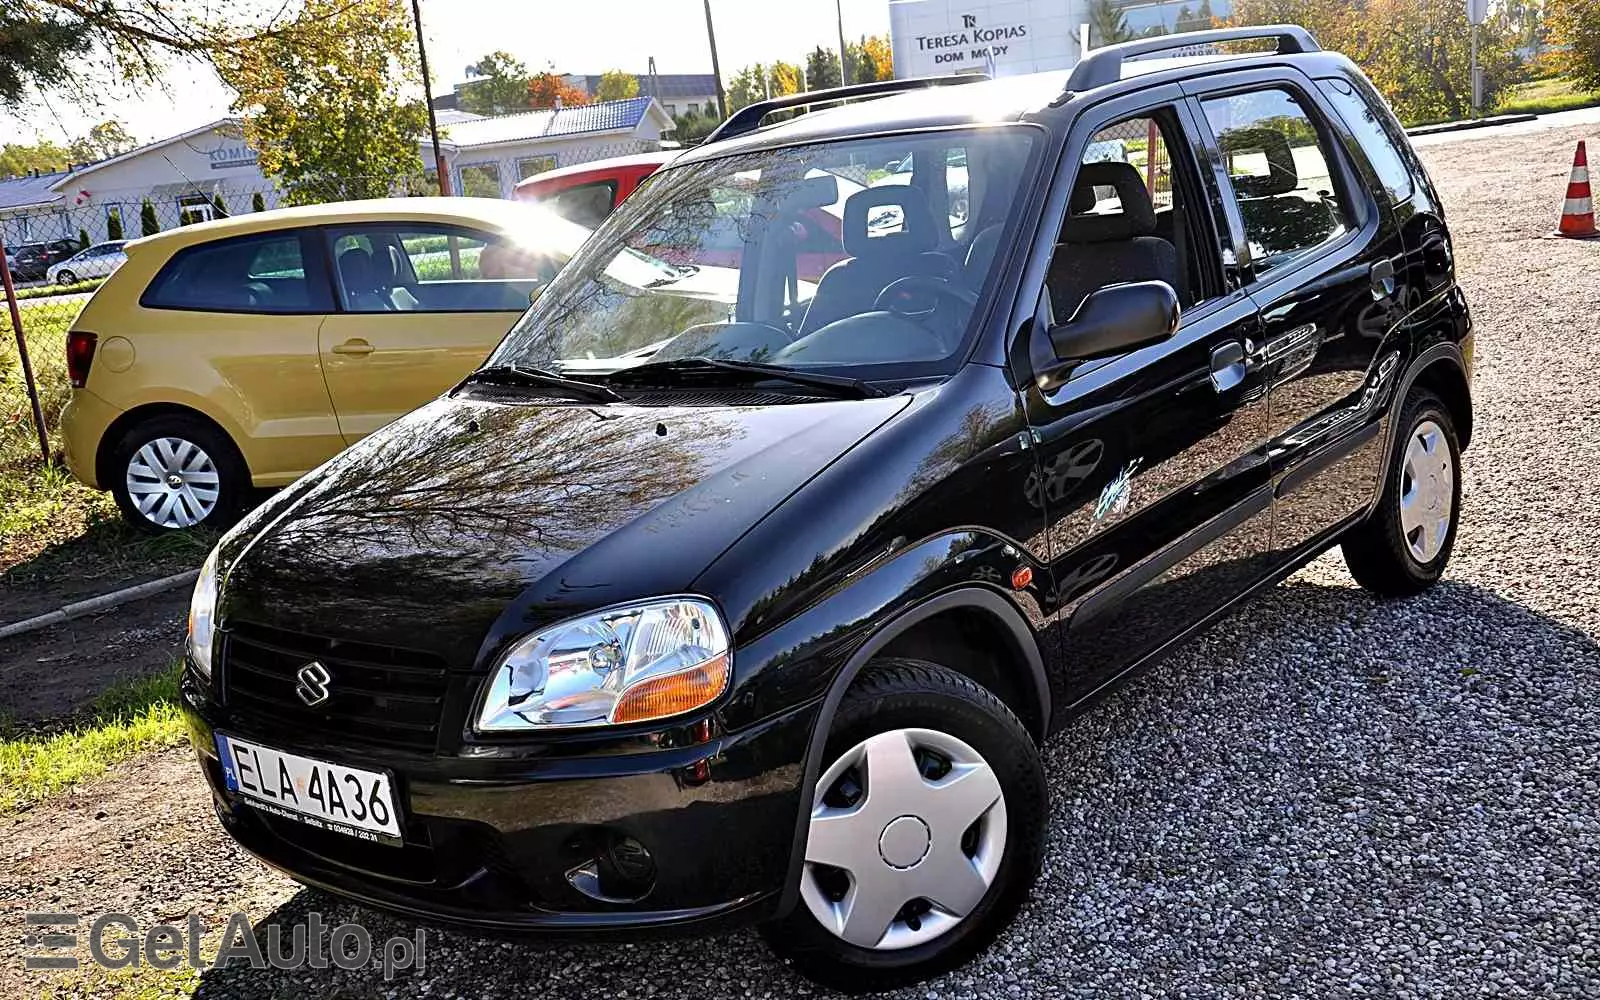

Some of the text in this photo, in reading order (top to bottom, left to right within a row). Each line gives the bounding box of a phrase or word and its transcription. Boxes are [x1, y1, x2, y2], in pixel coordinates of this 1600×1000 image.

[916, 25, 1027, 51] TERESA KOPIAS
[934, 51, 964, 64] DOM
[225, 766, 236, 781] PL
[232, 743, 391, 827] ELA 4A36
